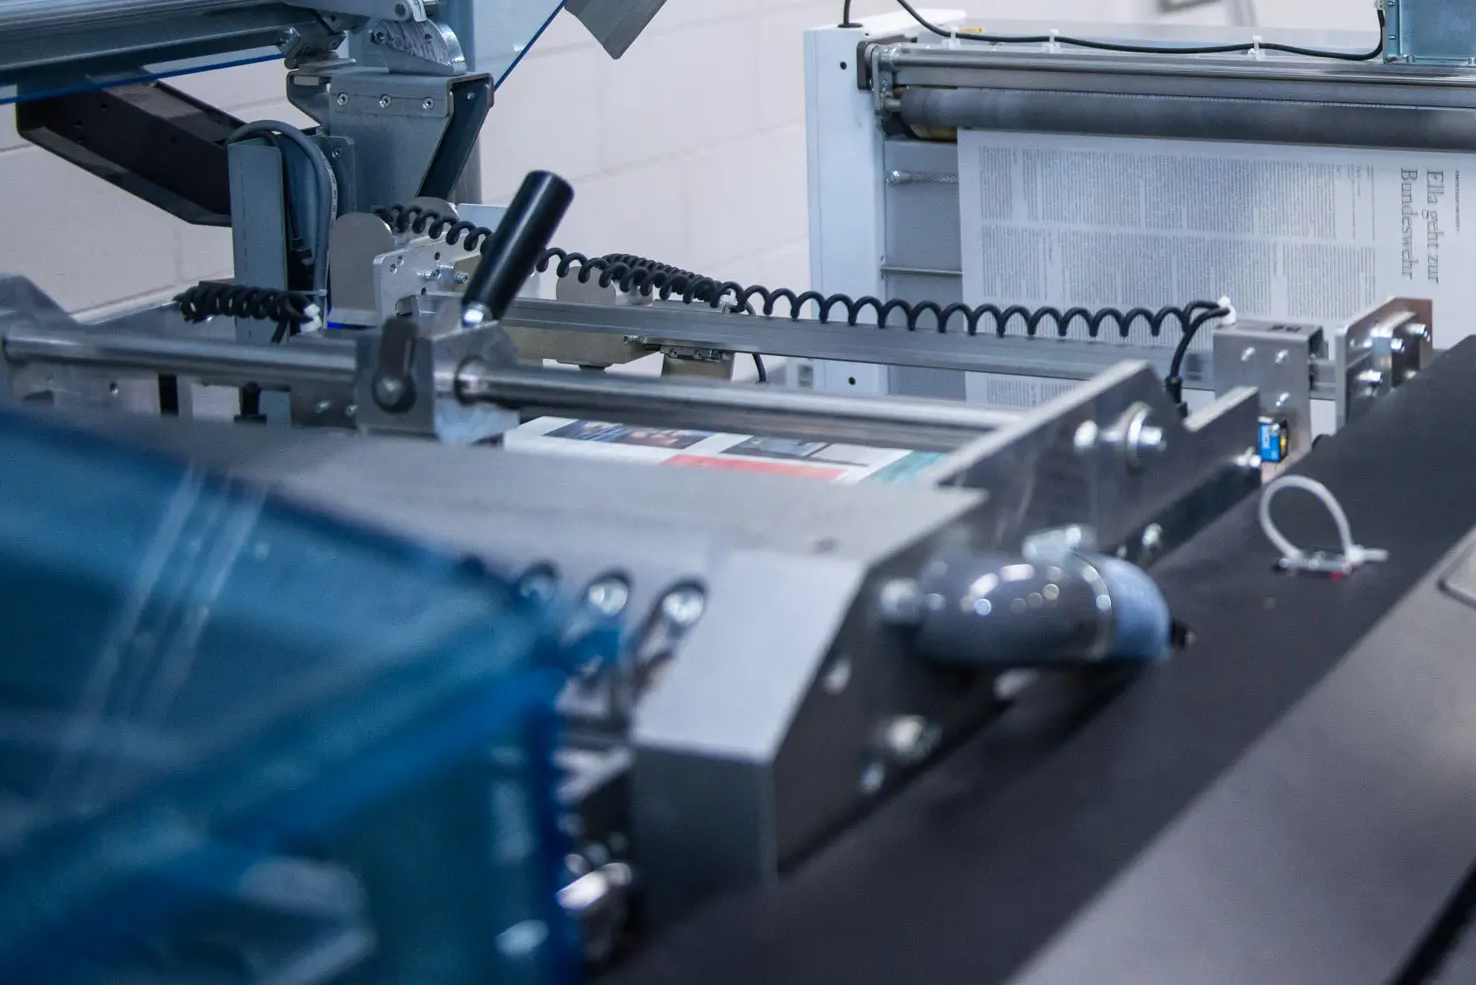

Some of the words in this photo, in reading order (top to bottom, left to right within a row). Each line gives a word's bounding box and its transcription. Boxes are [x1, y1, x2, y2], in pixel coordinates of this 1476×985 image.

[1427, 169, 1444, 204] Ella
[1401, 168, 1418, 279] Bundeswehr
[1422, 210, 1444, 249] geht
[1427, 254, 1439, 284] zur
